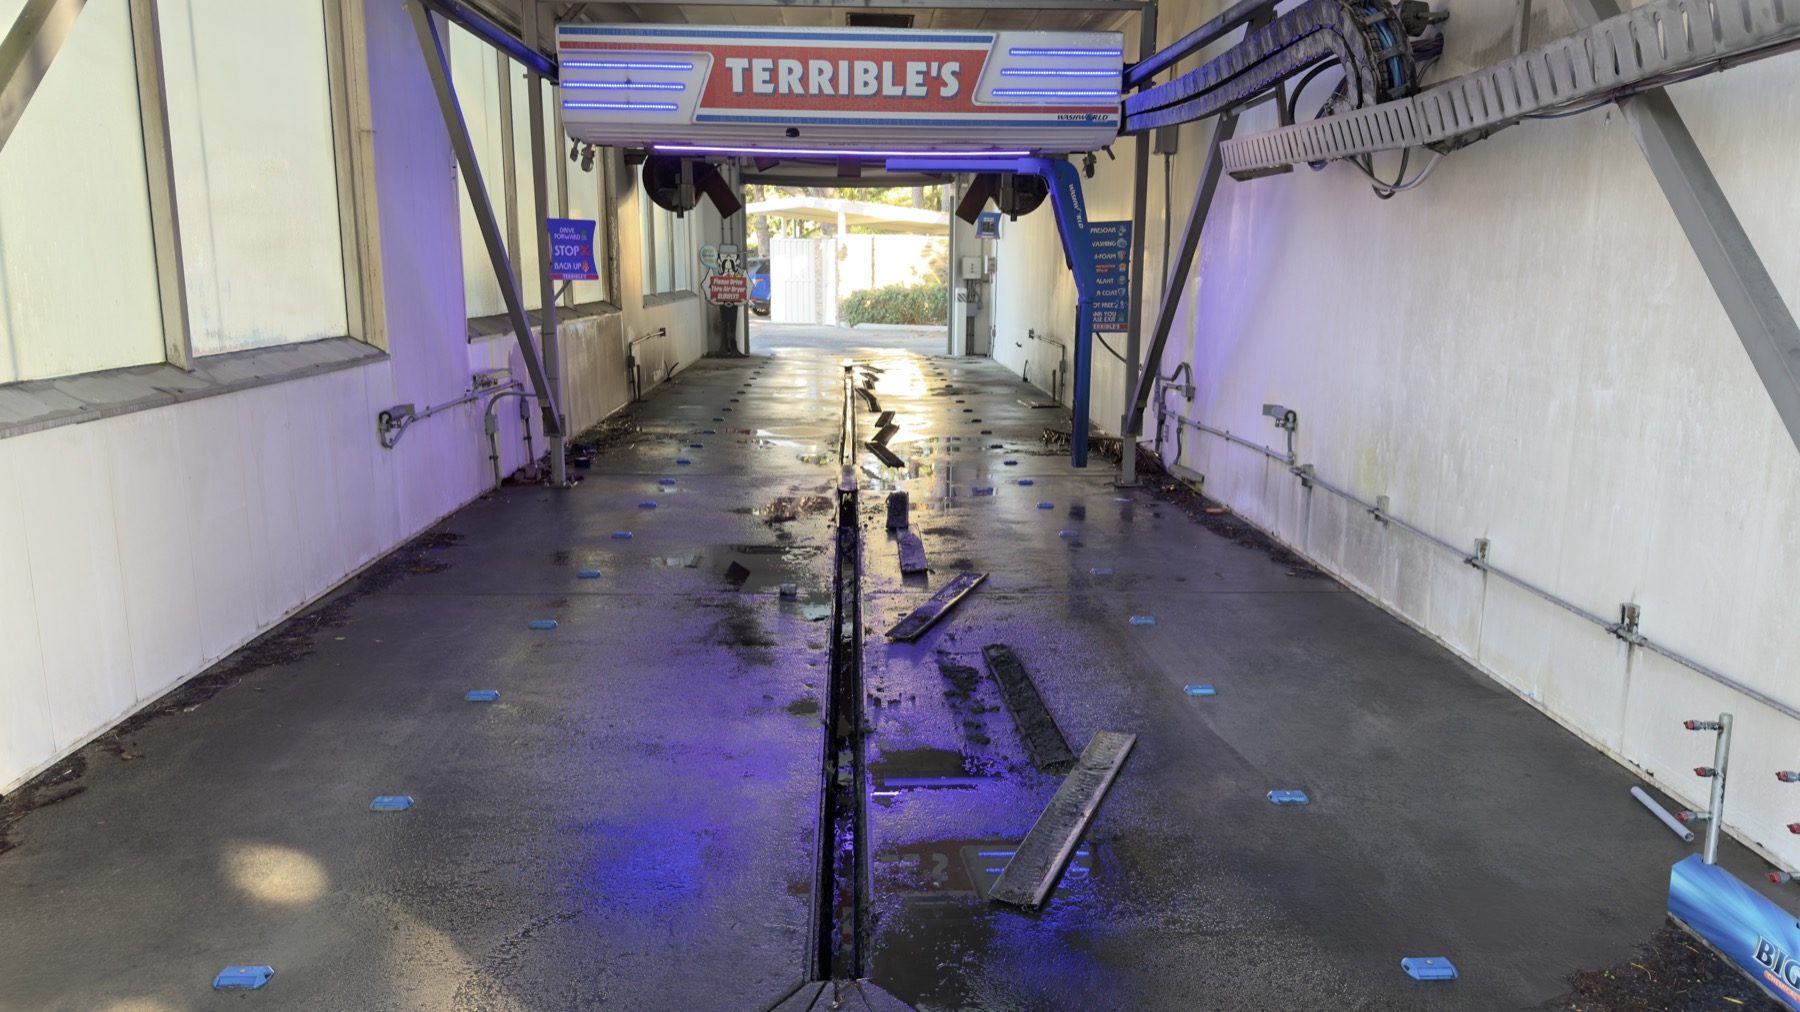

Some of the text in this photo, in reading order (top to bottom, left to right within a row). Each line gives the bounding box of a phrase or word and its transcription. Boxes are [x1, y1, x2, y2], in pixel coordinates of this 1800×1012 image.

[725, 57, 961, 98] TERRIBLE'S
[554, 245, 580, 256] STOP
[554, 262, 582, 270] BACK UP
